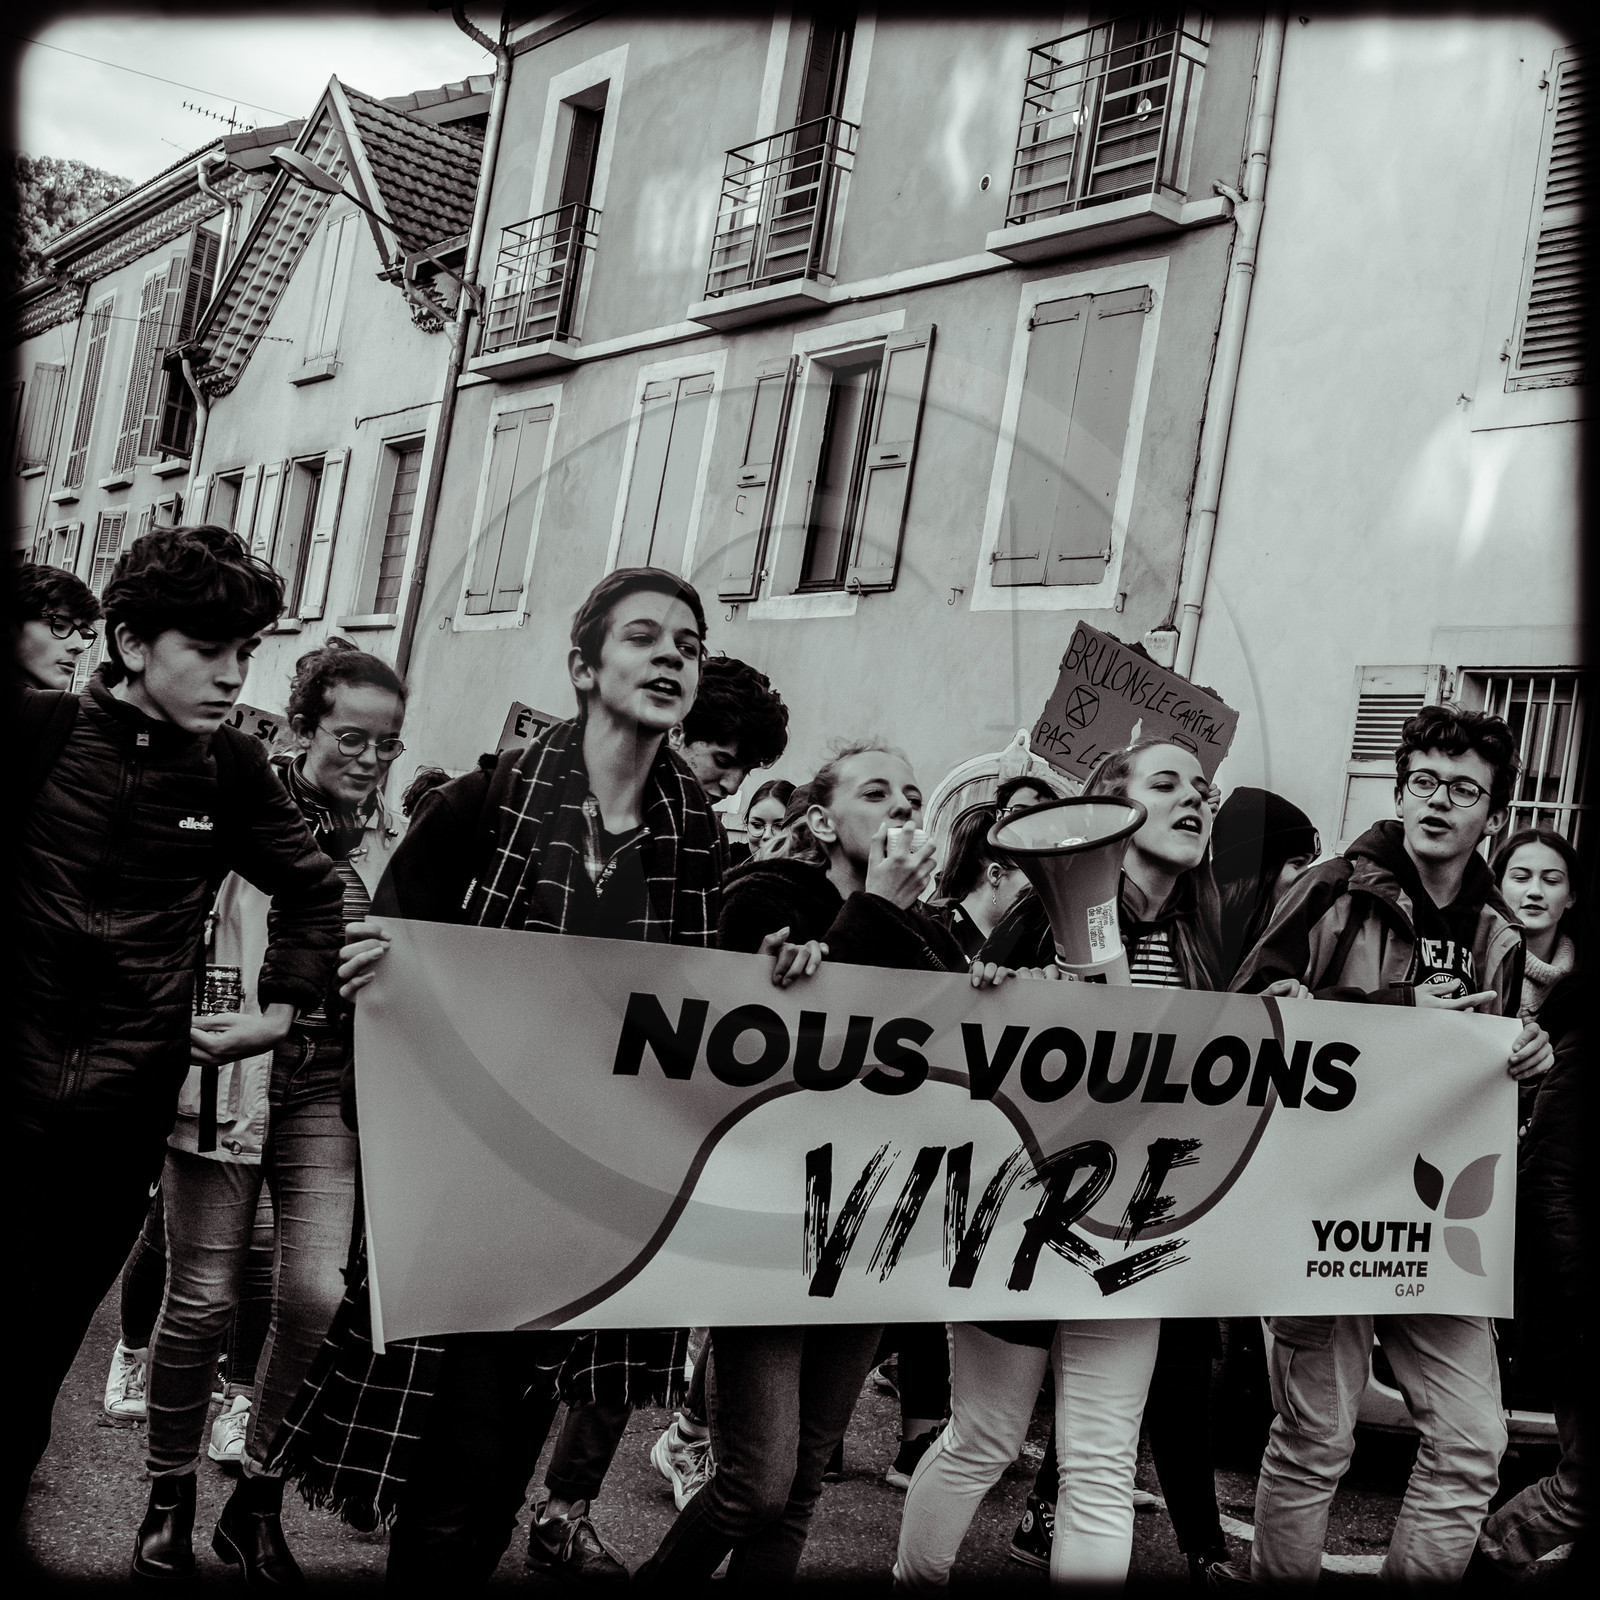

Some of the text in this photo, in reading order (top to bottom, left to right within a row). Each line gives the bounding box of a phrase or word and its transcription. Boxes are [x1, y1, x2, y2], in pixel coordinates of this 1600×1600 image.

[1064, 630, 1153, 705] BRULONS
[1145, 682, 1178, 714] LE
[1036, 721, 1075, 756] PAS
[178, 816, 214, 831] ellesse
[1088, 908, 1096, 917] de
[1089, 917, 1096, 925] la
[612, 992, 1363, 1112] NOUS VOULONS
[802, 1138, 1204, 1298] VIVRE
[1311, 1220, 1432, 1252] YOUTH
[1306, 1260, 1428, 1277] FOR CLIMATE
[1394, 1283, 1425, 1297] GAP
